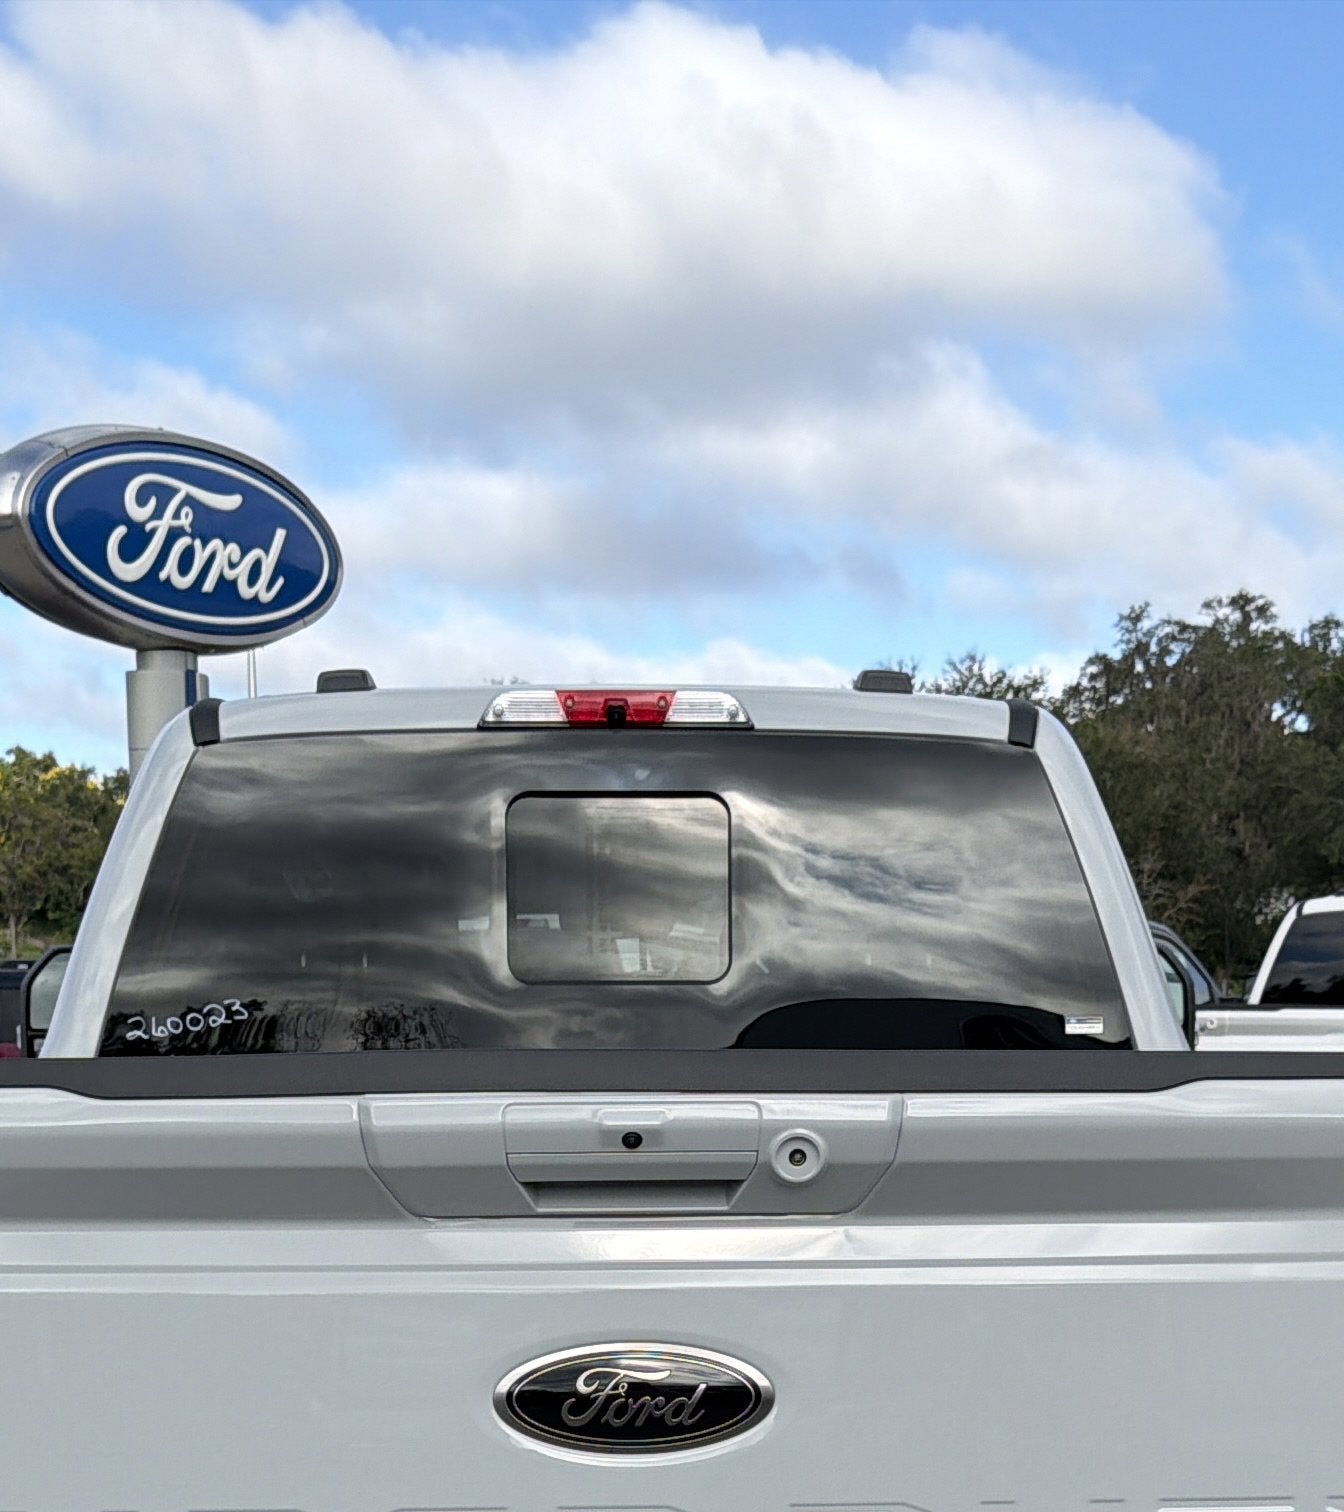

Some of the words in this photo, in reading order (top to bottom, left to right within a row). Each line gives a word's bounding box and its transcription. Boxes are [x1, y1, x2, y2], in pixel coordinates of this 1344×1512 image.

[107, 473, 287, 604] Ford
[125, 999, 249, 1041] 260023
[561, 1367, 707, 1428] Ford
